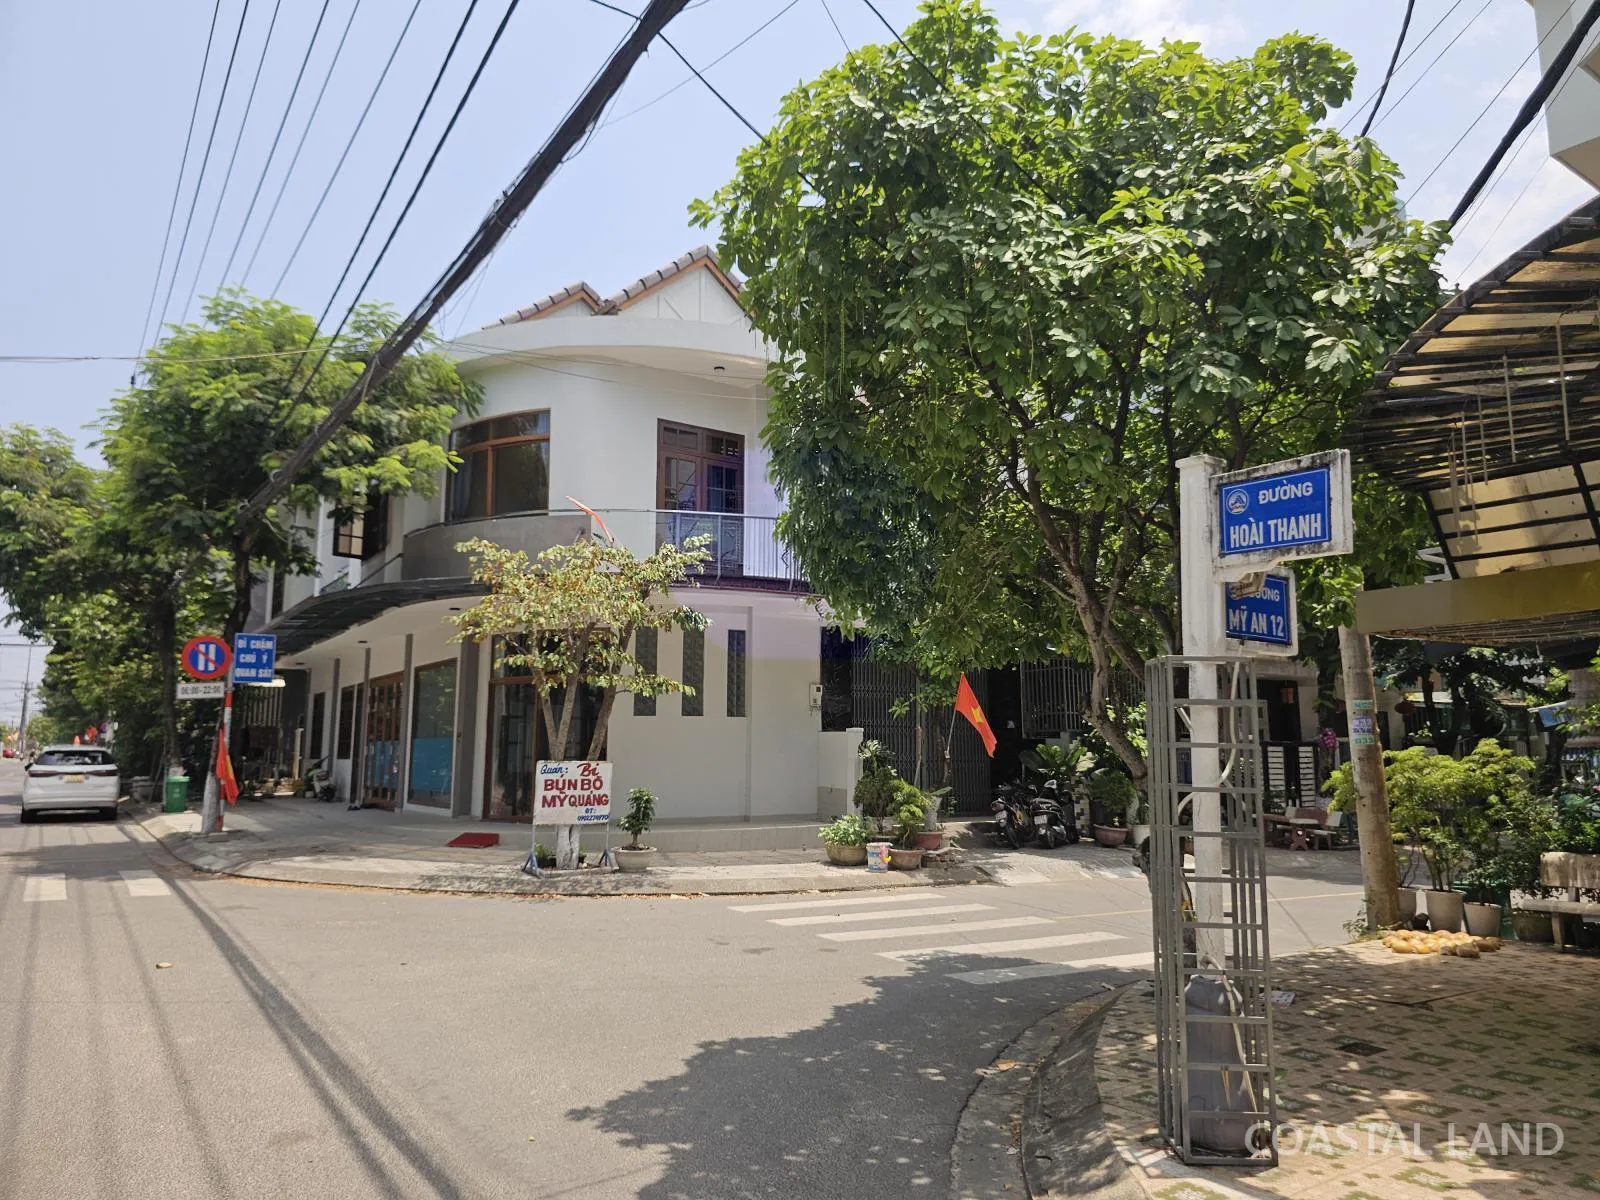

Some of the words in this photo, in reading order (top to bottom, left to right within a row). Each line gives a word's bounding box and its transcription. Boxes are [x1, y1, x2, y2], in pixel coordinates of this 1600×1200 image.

[1258, 480, 1313, 504] ĐƯỜNG
[1230, 517, 1264, 548] HOÀI
[1268, 513, 1322, 543] THANH
[1228, 605, 1248, 632] MỸ
[1250, 611, 1268, 635] AN
[1270, 614, 1284, 637] 12
[541, 790, 568, 809] MỸ
